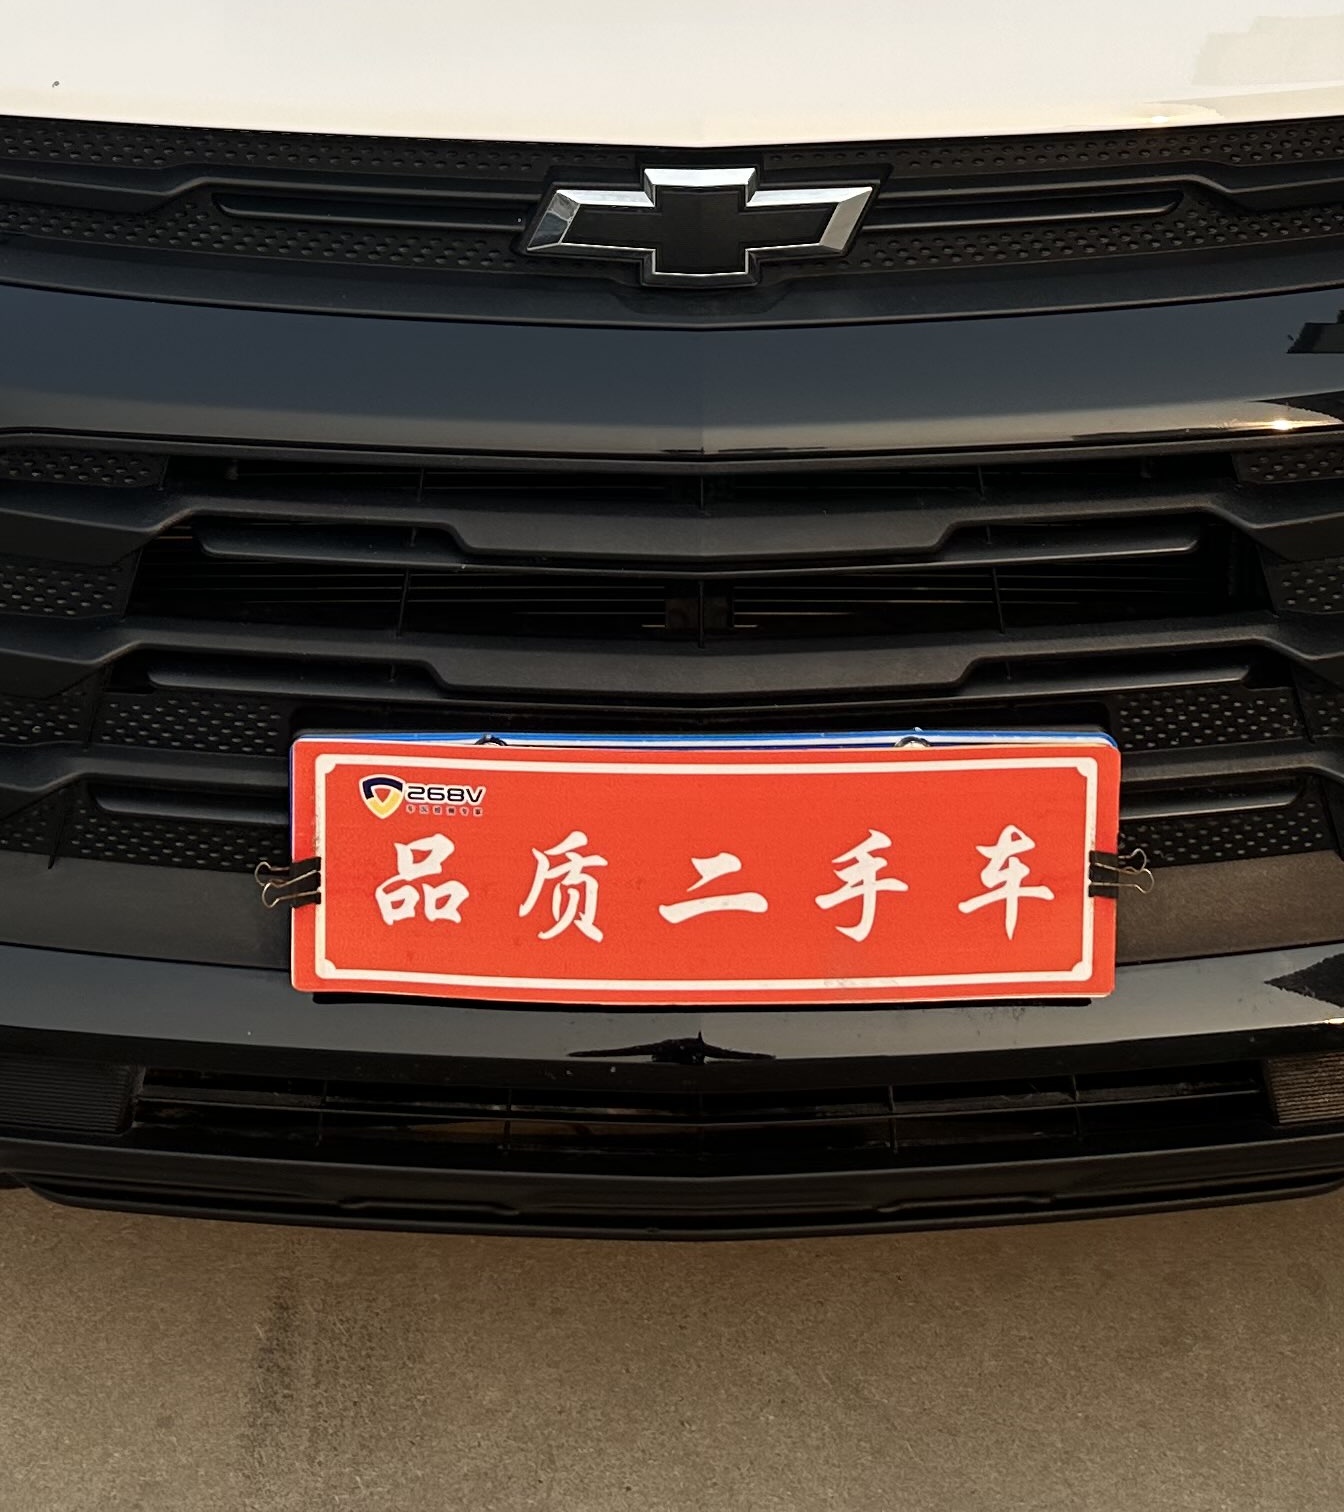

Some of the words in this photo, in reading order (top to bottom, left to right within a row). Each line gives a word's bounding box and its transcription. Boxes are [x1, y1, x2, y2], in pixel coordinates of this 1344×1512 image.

[406, 784, 484, 803] 268V
[374, 824, 1055, 942] 品质二手车
